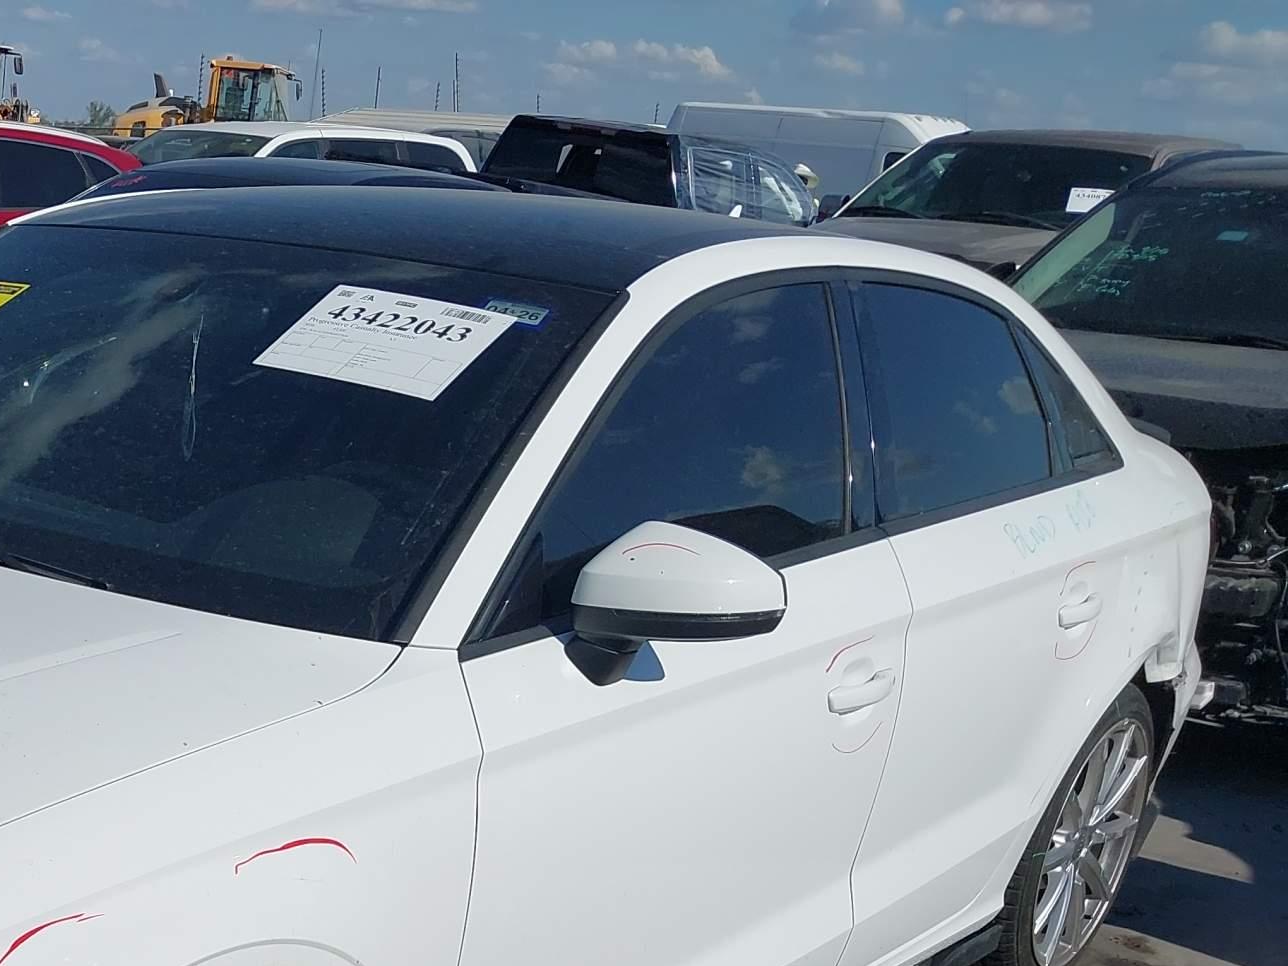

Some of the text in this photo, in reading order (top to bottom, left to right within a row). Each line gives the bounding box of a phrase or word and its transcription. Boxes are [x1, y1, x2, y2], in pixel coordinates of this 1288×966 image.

[516, 310, 541, 321] 26
[308, 316, 349, 328] Progressive
[328, 305, 472, 342] 43422043
